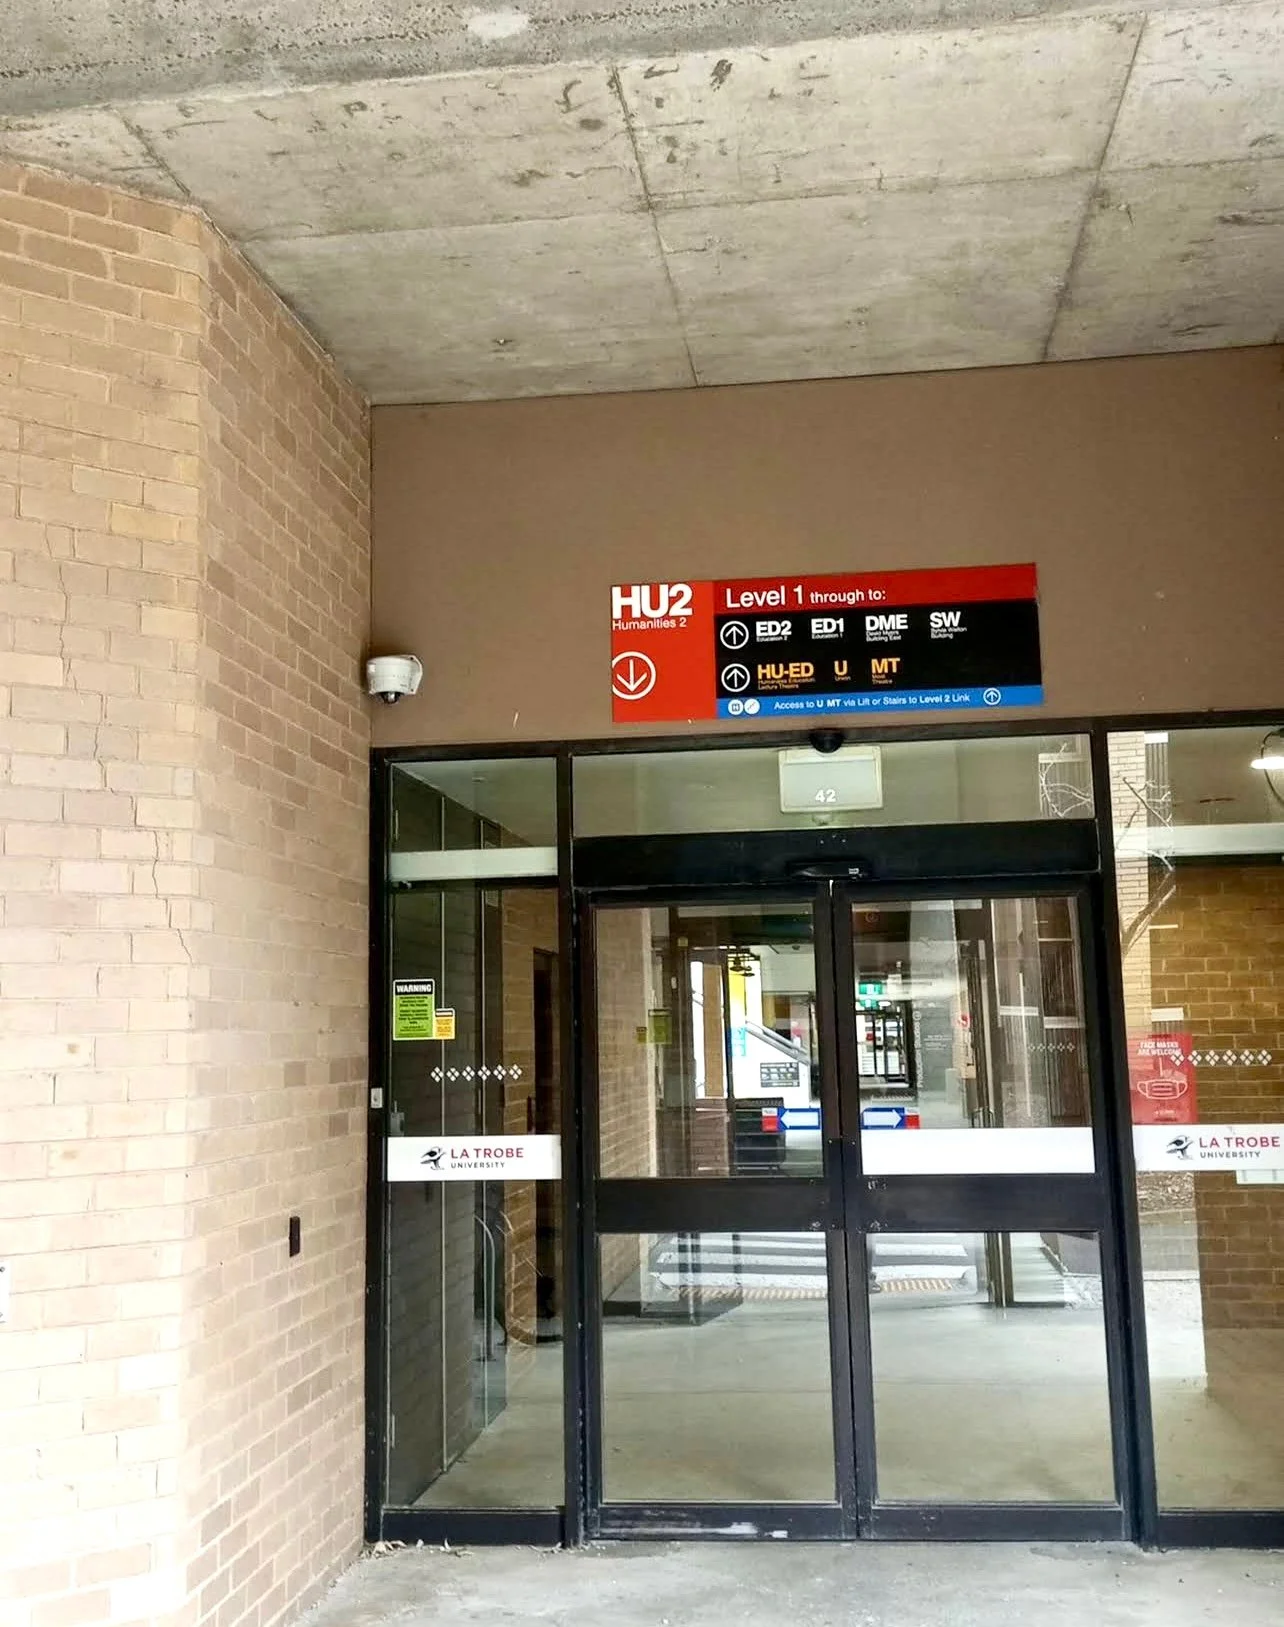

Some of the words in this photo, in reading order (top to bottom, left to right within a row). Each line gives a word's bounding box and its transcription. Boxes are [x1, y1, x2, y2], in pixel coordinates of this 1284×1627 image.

[612, 583, 693, 619] HU2
[726, 585, 786, 608] Level
[793, 584, 804, 605] 1
[810, 589, 865, 605] through
[868, 588, 886, 601] to:
[612, 618, 677, 631] Humanities
[679, 617, 687, 628] 2
[756, 620, 792, 636] ED2
[811, 617, 845, 634] ED1
[865, 613, 909, 631] DME
[929, 611, 961, 629] SW
[757, 662, 815, 680] HU-ED
[834, 660, 848, 676] U
[871, 657, 901, 674] MT
[774, 701, 804, 710] Access
[806, 701, 815, 709] to
[816, 700, 824, 708] U
[827, 699, 842, 708] MT
[843, 698, 856, 707] via
[857, 697, 871, 706] Lift
[872, 698, 881, 706] or
[883, 696, 907, 705] Stairs
[909, 695, 918, 704] to
[919, 695, 943, 704] Level
[944, 694, 951, 703] 2
[952, 693, 971, 702] Link
[815, 788, 837, 803] 42
[396, 984, 432, 993] WARNING
[1199, 1136, 1220, 1148] LA
[1224, 1136, 1281, 1148] TROBE
[451, 1147, 470, 1159] LA
[473, 1147, 525, 1159] TROBE
[1200, 1150, 1262, 1159] UNIVERSITY
[451, 1161, 506, 1169] UNIVERSITY
